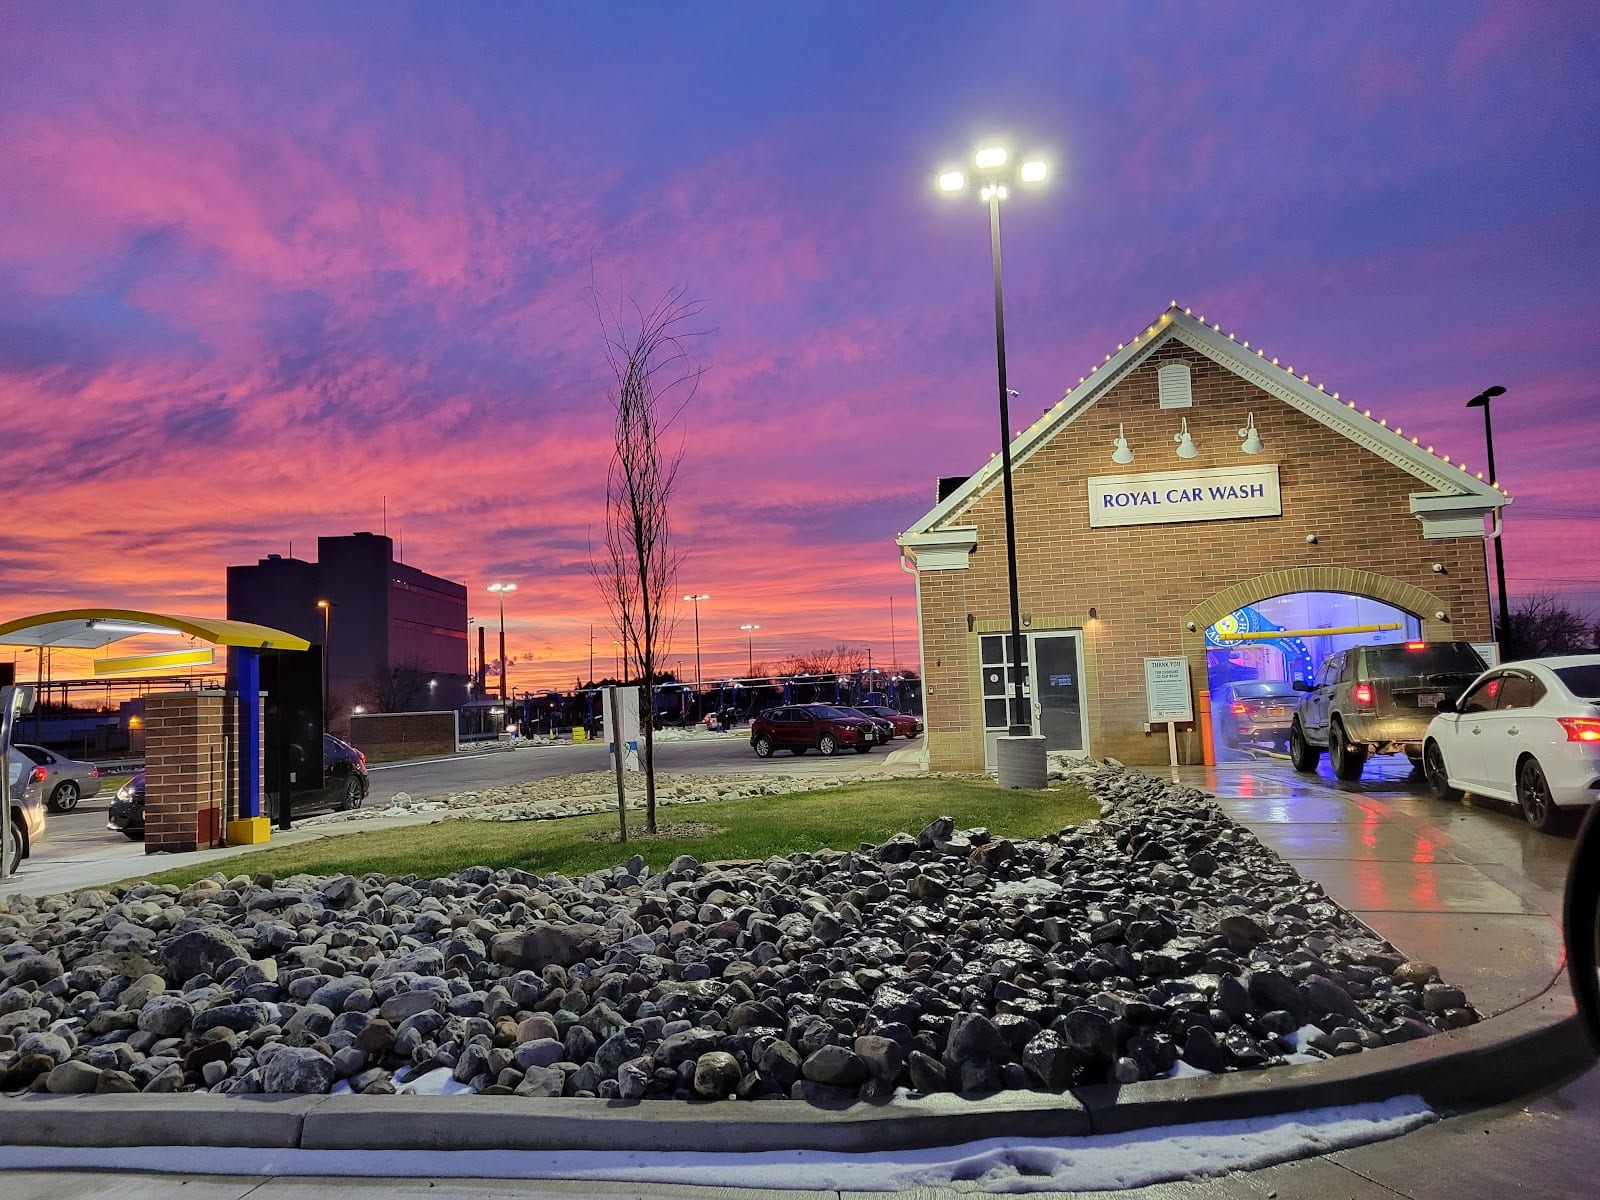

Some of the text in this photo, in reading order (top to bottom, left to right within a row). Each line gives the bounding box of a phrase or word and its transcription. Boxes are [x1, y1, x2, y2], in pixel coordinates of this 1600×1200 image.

[1103, 483, 1264, 508] ROYAL CAR WASH
